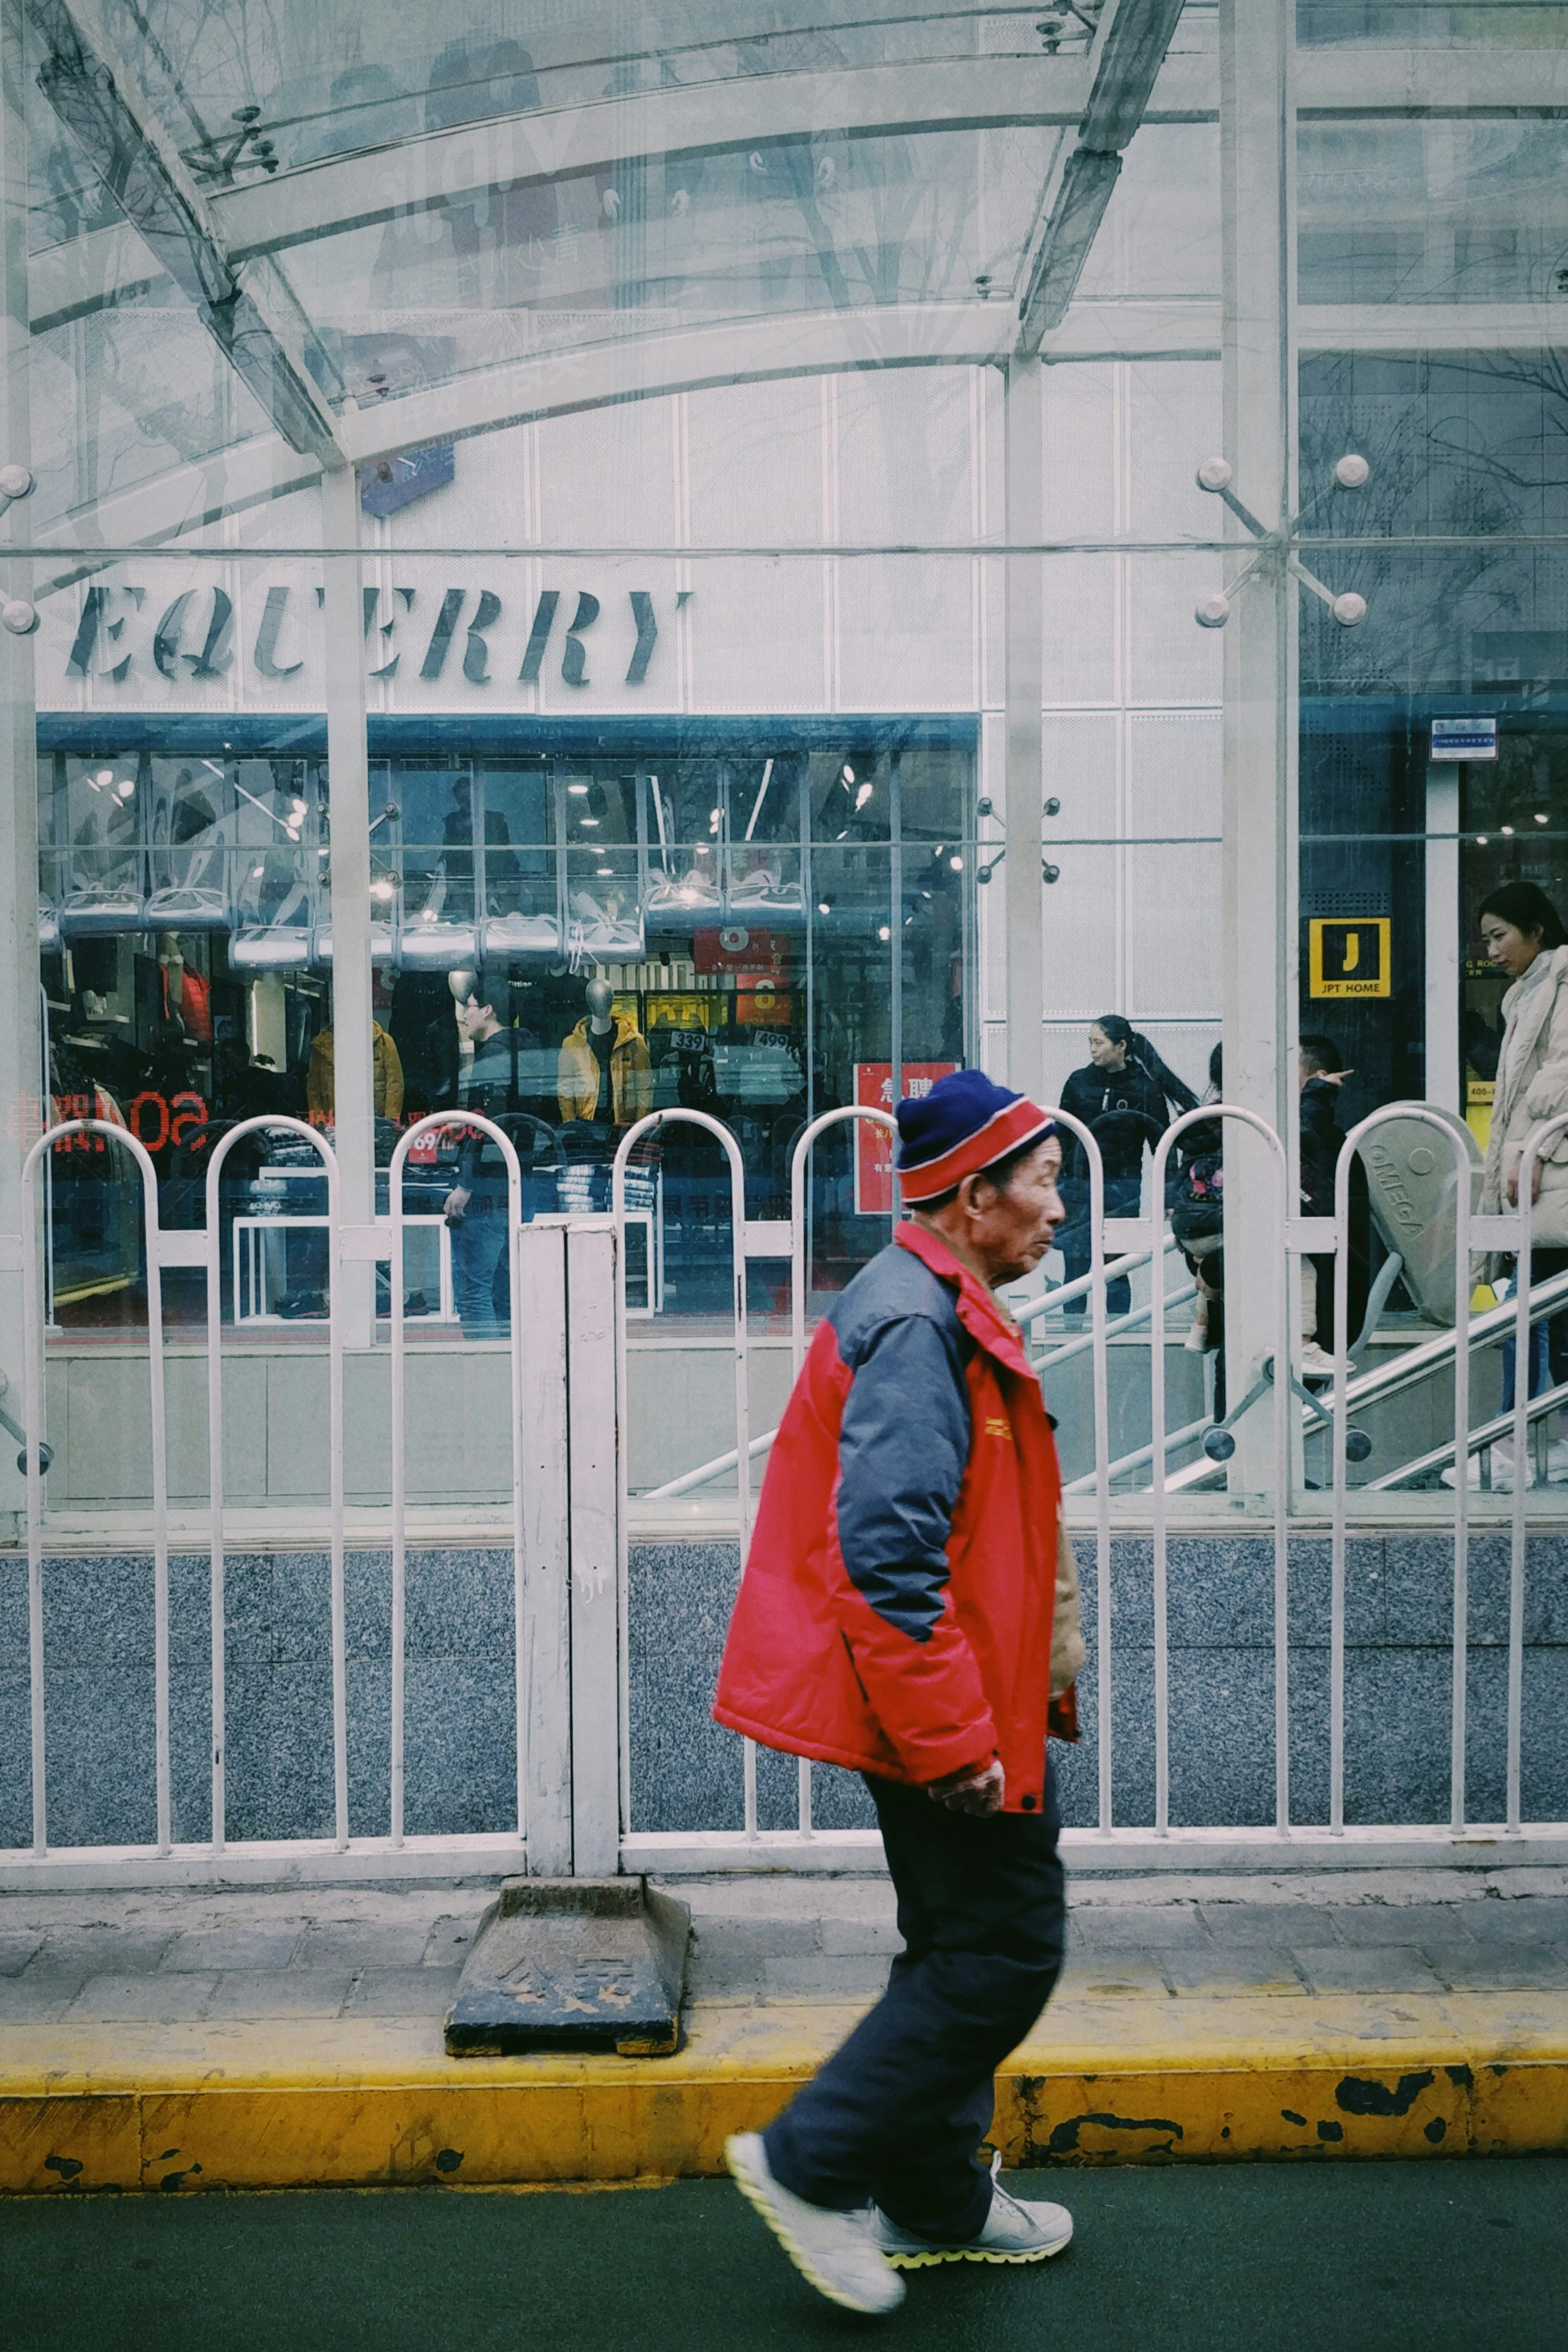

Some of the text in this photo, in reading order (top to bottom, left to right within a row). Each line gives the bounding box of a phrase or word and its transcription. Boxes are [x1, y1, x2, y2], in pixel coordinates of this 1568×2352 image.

[65, 586, 694, 686] EQUERRY
[1343, 933, 1359, 972] J
[1321, 983, 1380, 993] JPT HOME
[676, 1033, 703, 1049] 339
[759, 1033, 788, 1049] 499
[879, 1077, 933, 1102] 急聘
[414, 1132, 436, 1151] 69
[1368, 1144, 1425, 1242] OMEGA
